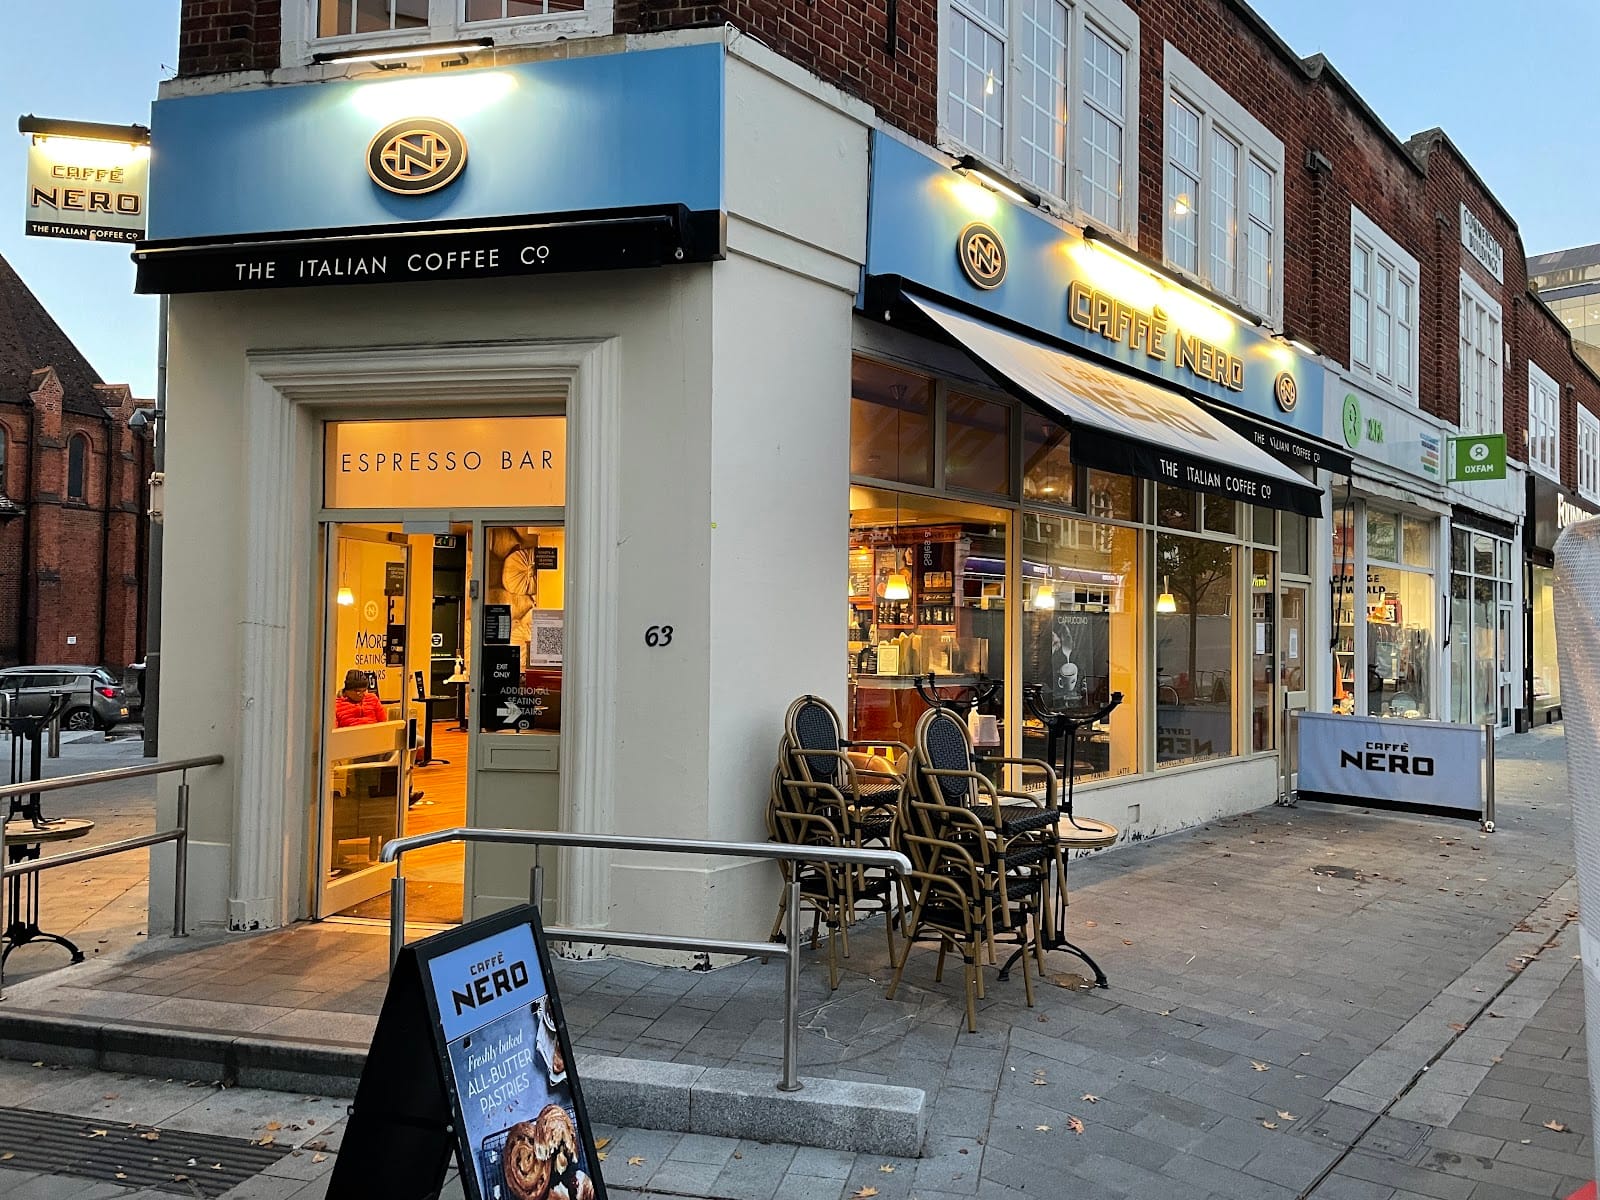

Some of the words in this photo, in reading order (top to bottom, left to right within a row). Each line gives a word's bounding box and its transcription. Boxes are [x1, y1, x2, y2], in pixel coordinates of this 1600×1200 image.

[31, 184, 141, 215] NERO
[32, 224, 49, 233] THE
[51, 226, 88, 236] ITALIAN
[89, 230, 124, 239] COFFEE
[236, 262, 276, 281] THE
[299, 256, 388, 278] ITALIAN
[407, 248, 500, 272] COFFEE
[1175, 329, 1244, 392] NERO
[342, 451, 482, 472] ESPRESSO
[501, 450, 553, 469] BAR
[1254, 432, 1265, 445] THE
[1292, 444, 1311, 461] COFFEE
[1160, 459, 1178, 478] THE
[1187, 466, 1221, 488] ITALIAN
[1226, 476, 1256, 496] COFFEE
[1464, 464, 1494, 474] OXFAM
[1333, 574, 1380, 583] CHAGE
[645, 625, 673, 647] 63
[500, 687, 550, 696] ADDITIONAL
[507, 697, 542, 705] SEATING
[1341, 749, 1434, 776] NERO
[451, 960, 528, 1016] NERO
[468, 1045, 497, 1072] Freshly
[499, 1028, 522, 1055] baked
[468, 1048, 532, 1099] ALL-BUTTER
[480, 1072, 529, 1114] PASTRIES
